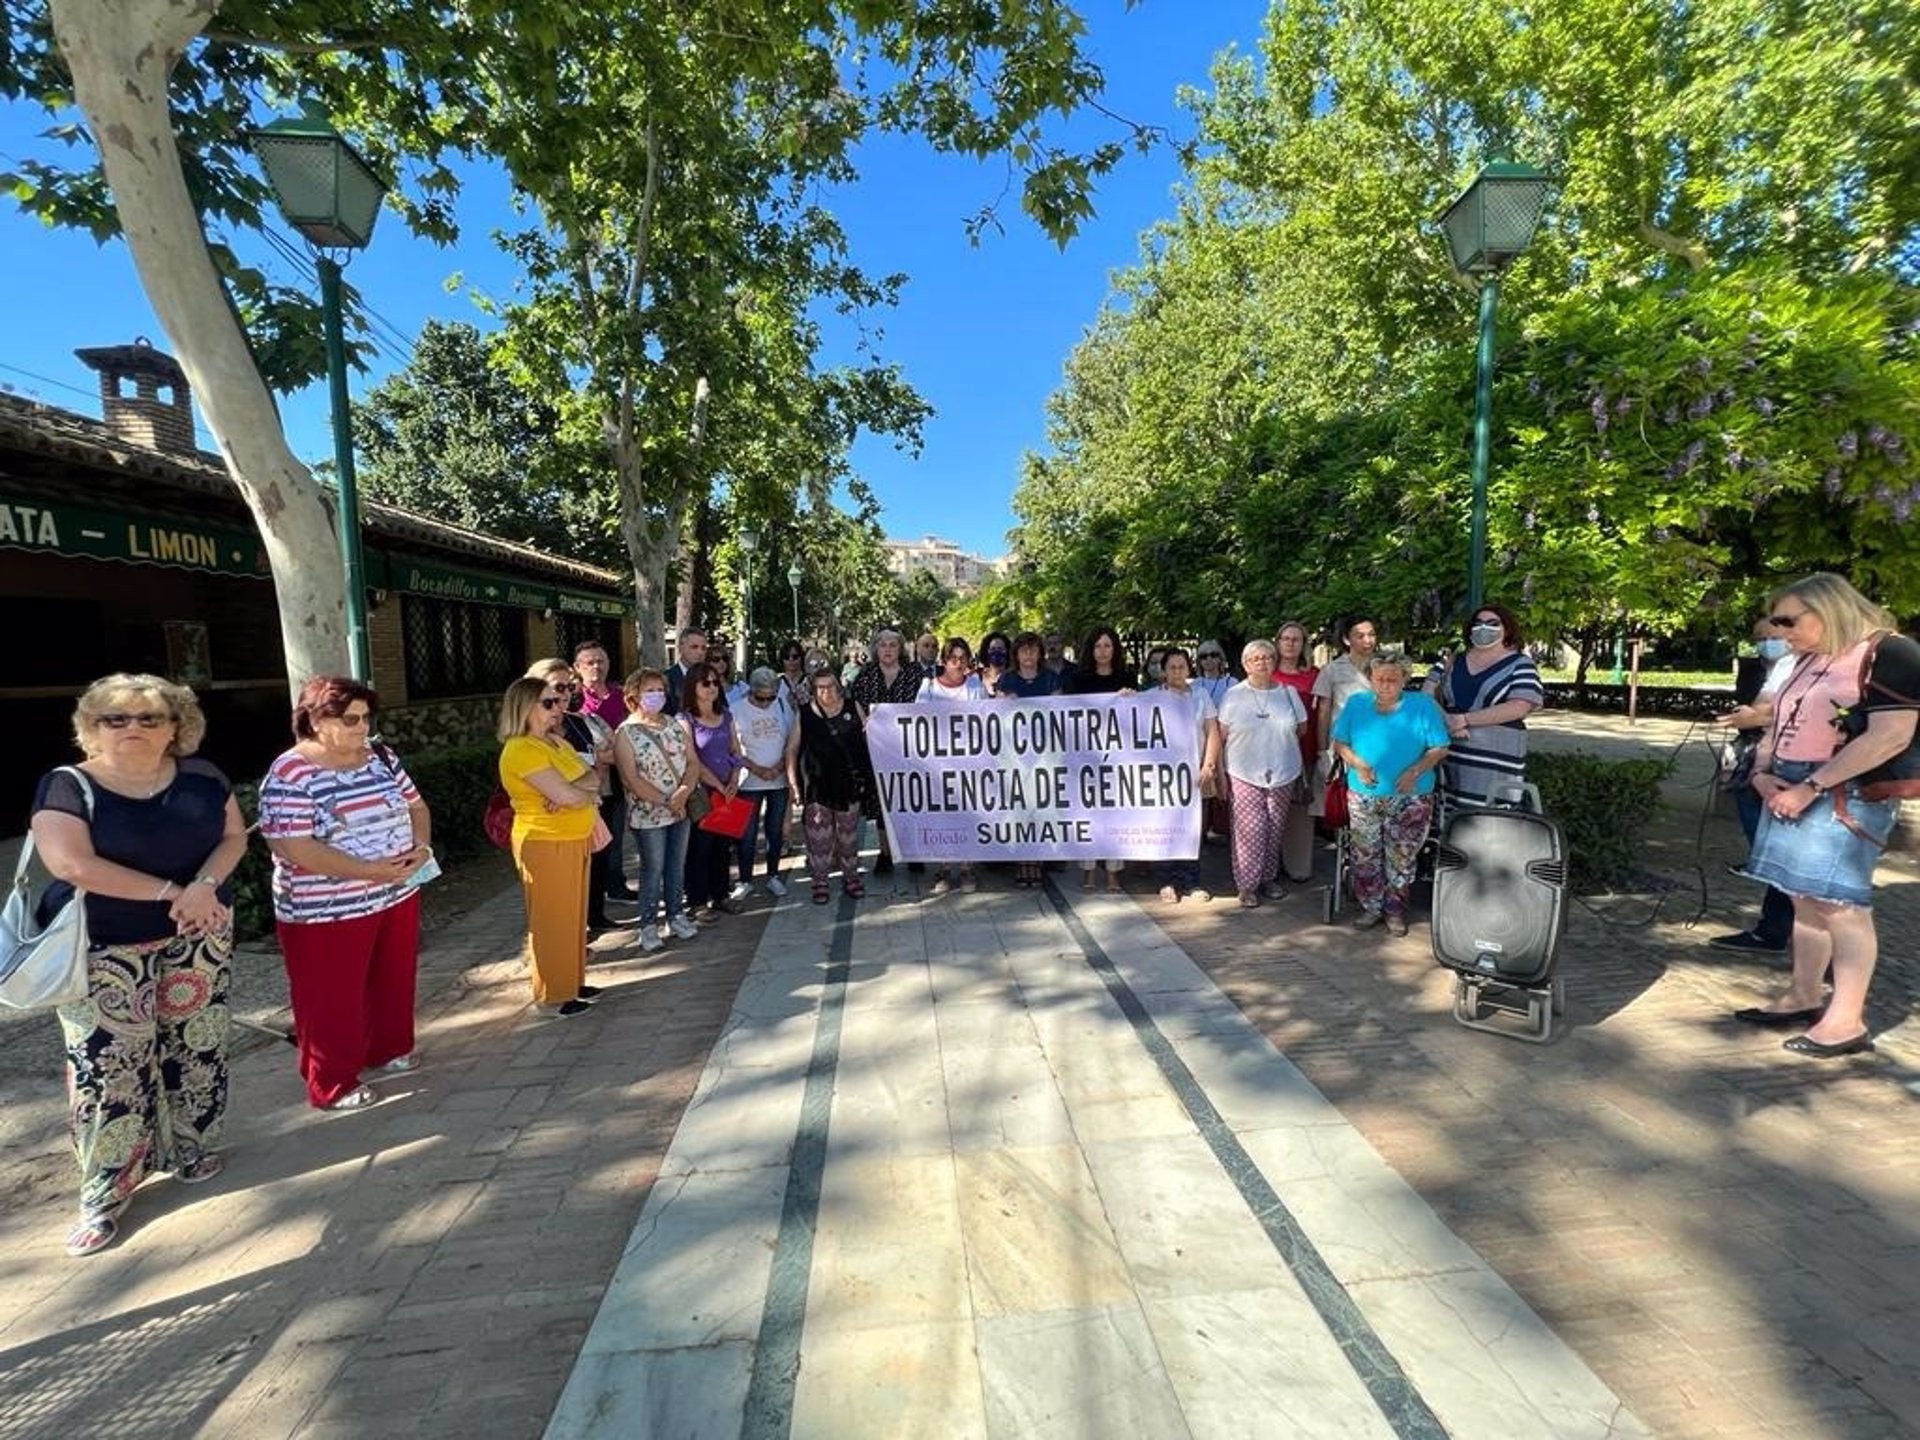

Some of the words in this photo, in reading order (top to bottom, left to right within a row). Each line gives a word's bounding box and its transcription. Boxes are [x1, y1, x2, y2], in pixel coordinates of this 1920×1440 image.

[128, 523, 218, 568] LIMON
[897, 712, 1001, 759] TOLEDO
[1012, 707, 1123, 755] CONTRA
[1132, 706, 1168, 749] LA
[878, 768, 1027, 813] VIOLENCIA
[1035, 766, 1070, 809] DE
[1080, 753, 1192, 809] GÉNERO
[920, 827, 968, 846] Toledo
[976, 821, 1092, 845] SUMATE
